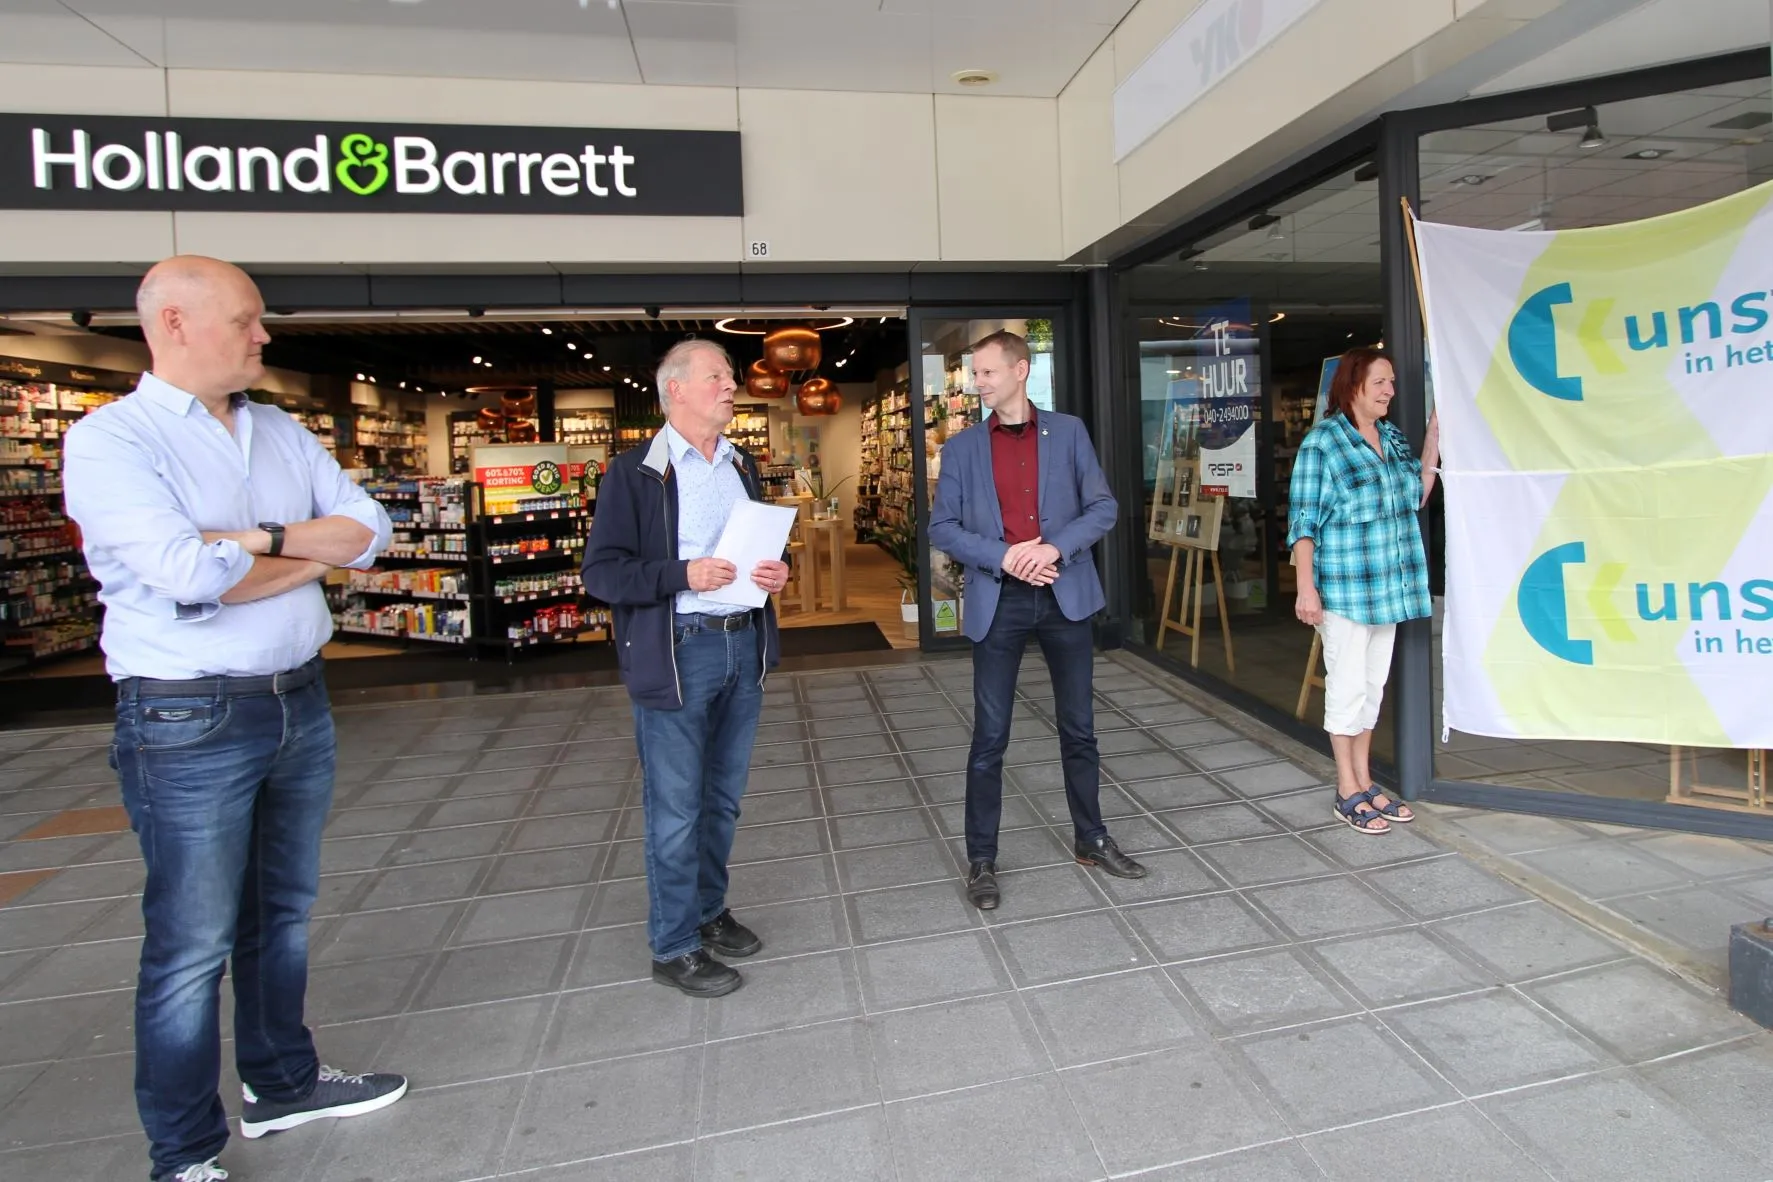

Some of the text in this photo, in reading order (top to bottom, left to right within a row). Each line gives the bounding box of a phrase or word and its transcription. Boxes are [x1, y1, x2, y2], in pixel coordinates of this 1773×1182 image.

[752, 242, 767, 256] 68
[1210, 319, 1231, 357] TE
[1685, 352, 1713, 374] in
[1202, 358, 1248, 399] HUUR
[1208, 463, 1234, 477] RSP
[535, 482, 558, 493] DEALS
[1695, 629, 1773, 654] in he
